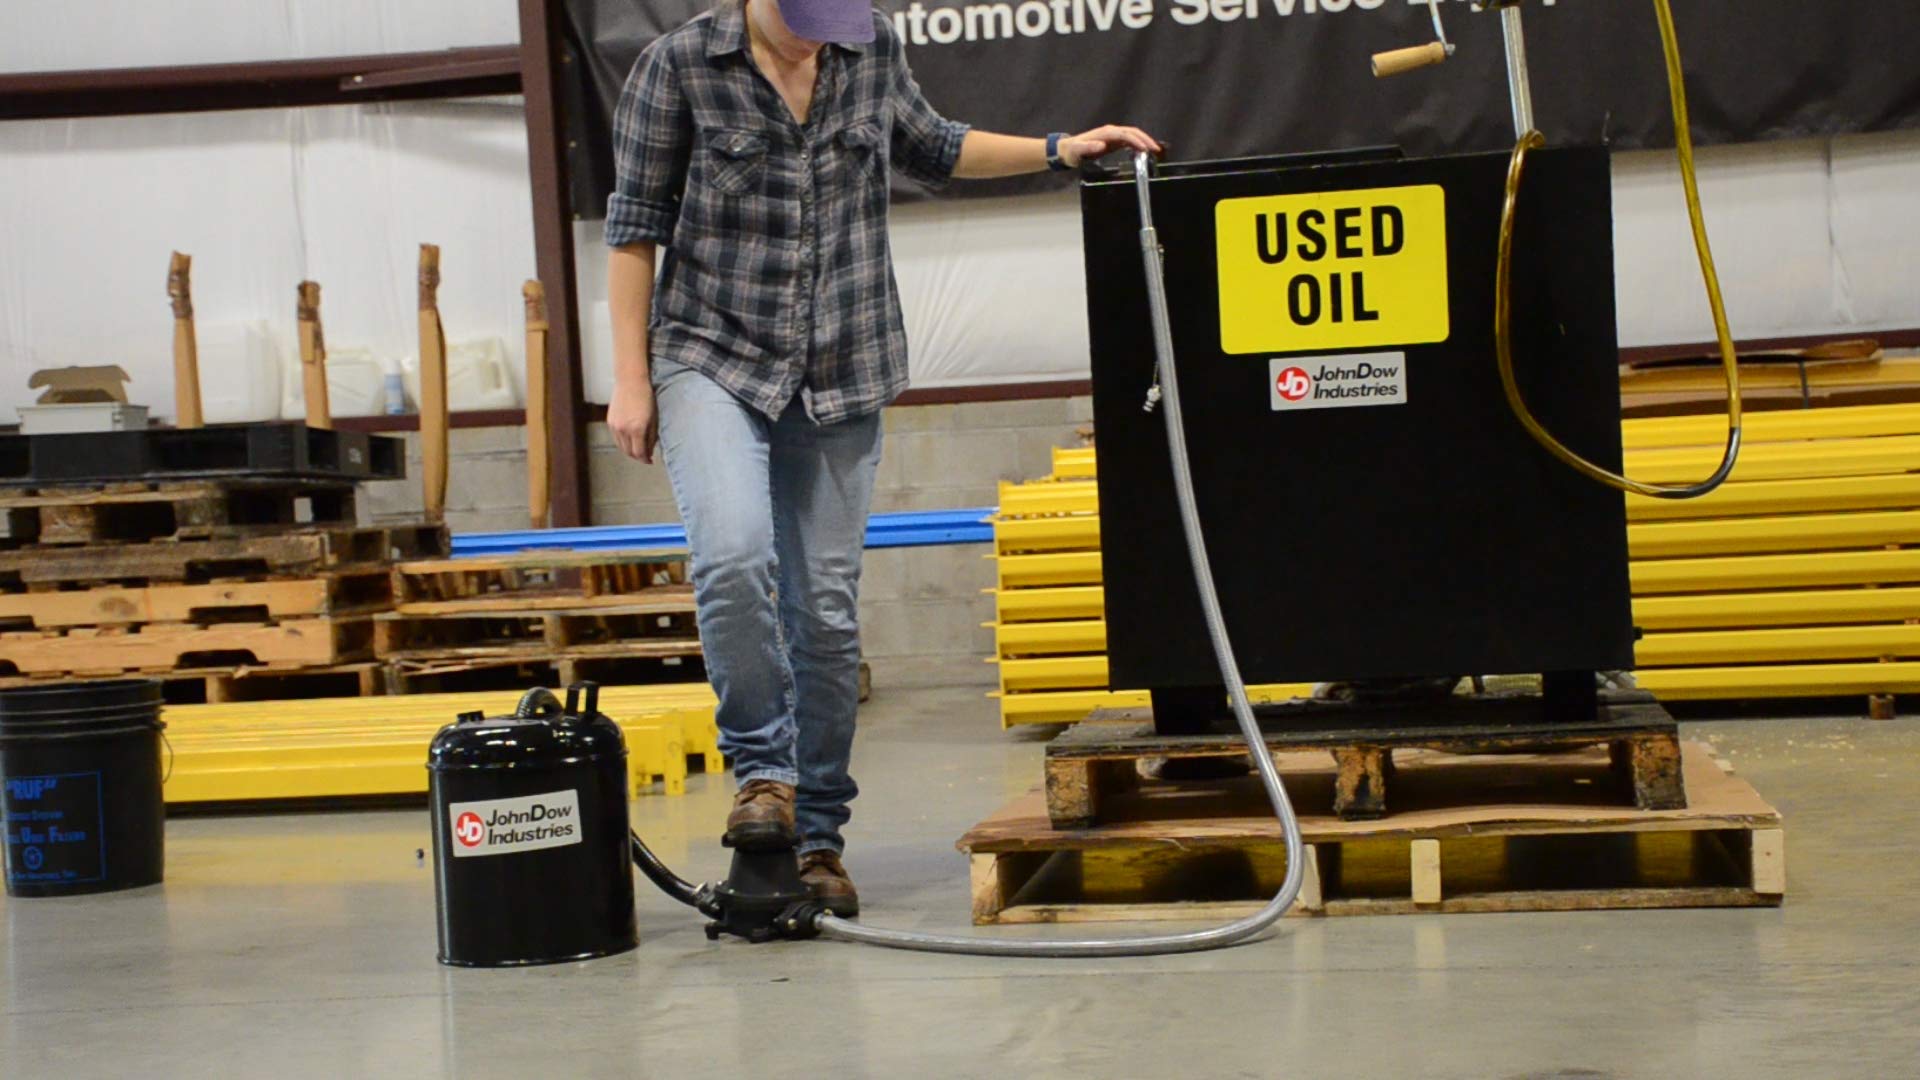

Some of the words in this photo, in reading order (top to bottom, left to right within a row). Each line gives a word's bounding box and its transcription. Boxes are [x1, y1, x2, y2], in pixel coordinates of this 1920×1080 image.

[1255, 205, 1404, 264] USED
[1287, 271, 1379, 326] OIL
[1313, 362, 1398, 382] JohnDow
[1278, 372, 1309, 396] JD
[1313, 380, 1398, 400] Industries
[486, 803, 572, 826] JohnDow
[457, 816, 483, 842] JD
[488, 823, 573, 845] Industries
